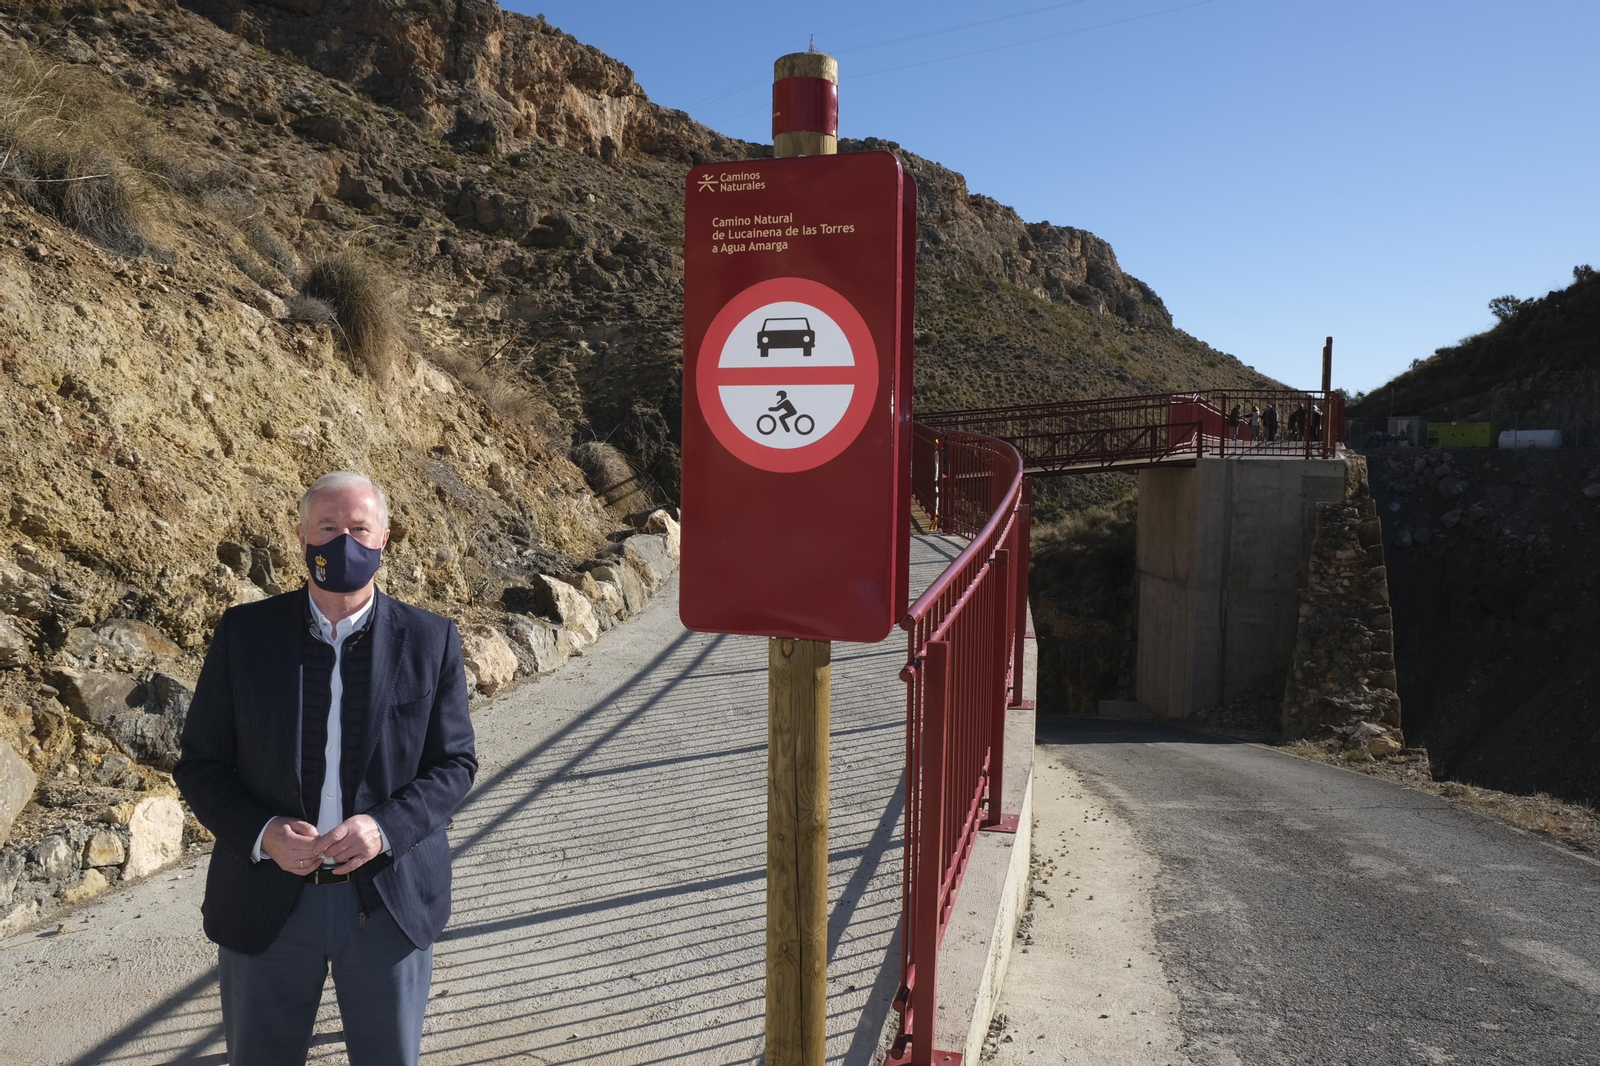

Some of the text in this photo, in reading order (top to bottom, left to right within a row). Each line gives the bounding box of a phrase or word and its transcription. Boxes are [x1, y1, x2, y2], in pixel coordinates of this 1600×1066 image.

[720, 172, 760, 182] Caminos
[720, 180, 766, 192] Naturales
[712, 212, 793, 228] Camino Natural
[712, 224, 855, 240] de Lucainena de las Torres
[712, 240, 788, 255] a Agua Amarga
